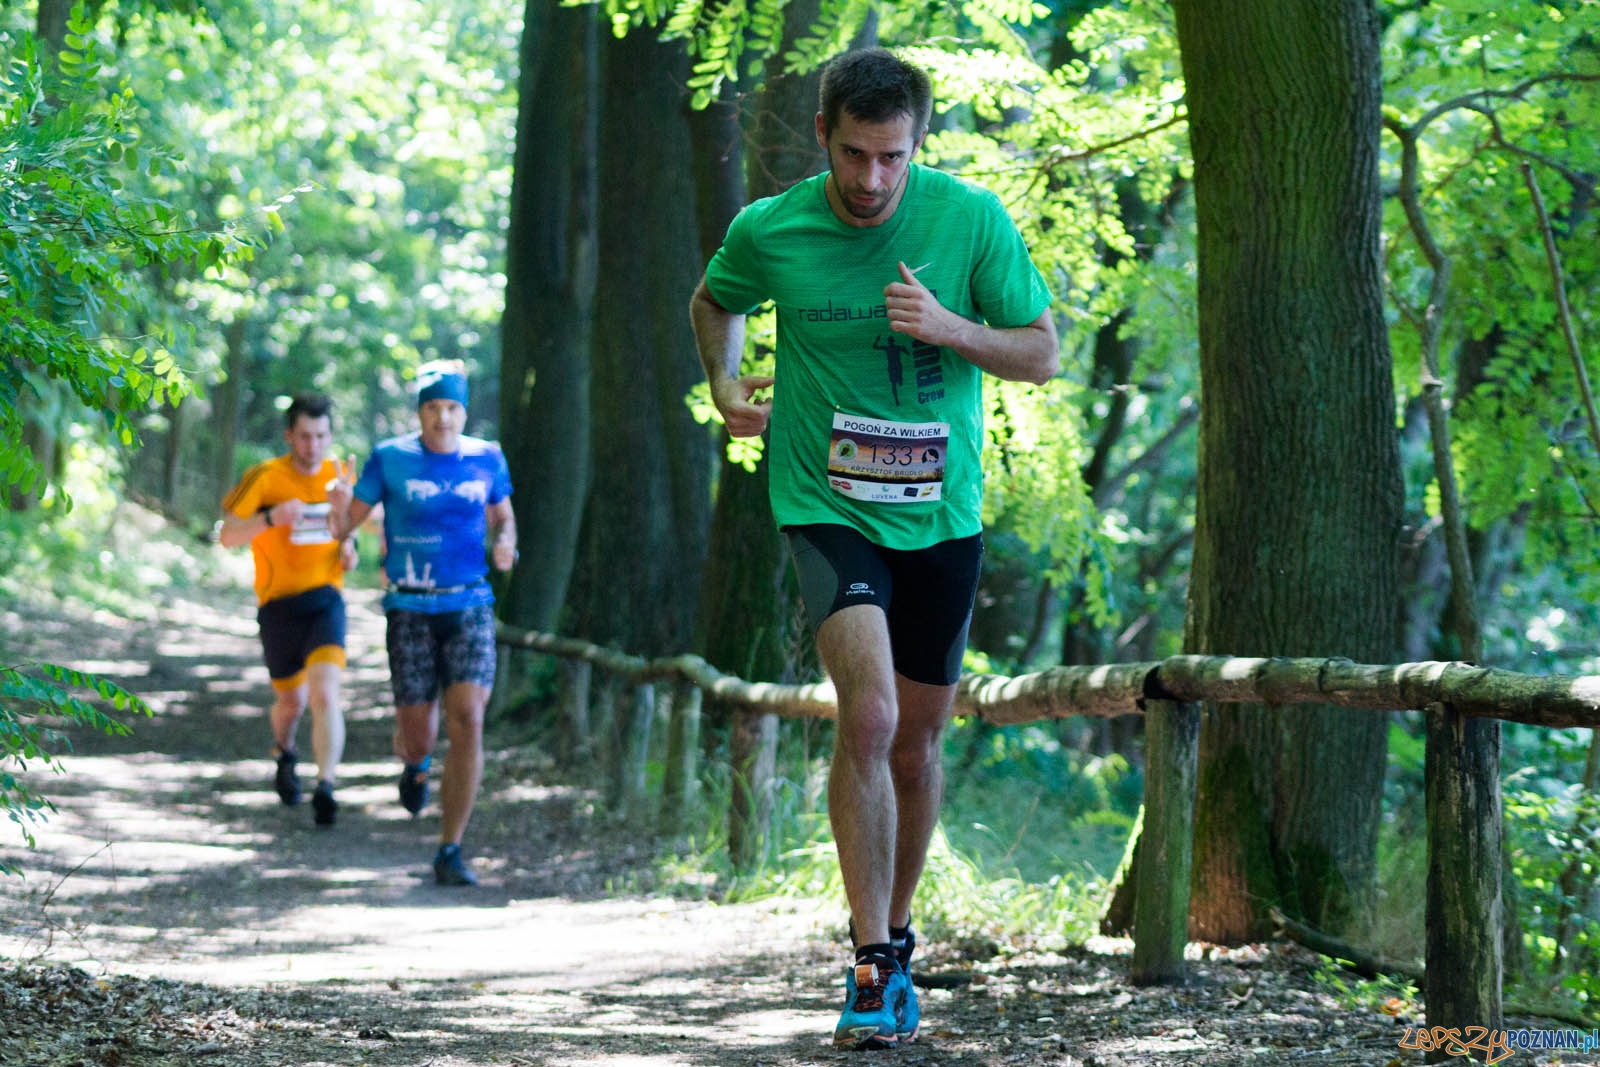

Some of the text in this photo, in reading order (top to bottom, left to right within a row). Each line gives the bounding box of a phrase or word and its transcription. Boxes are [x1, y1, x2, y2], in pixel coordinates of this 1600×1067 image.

[798, 299, 888, 322] radawa
[918, 388, 945, 404] Crew
[843, 420, 941, 437] POGOŃ ZA WILKIEM
[869, 443, 913, 466] 133
